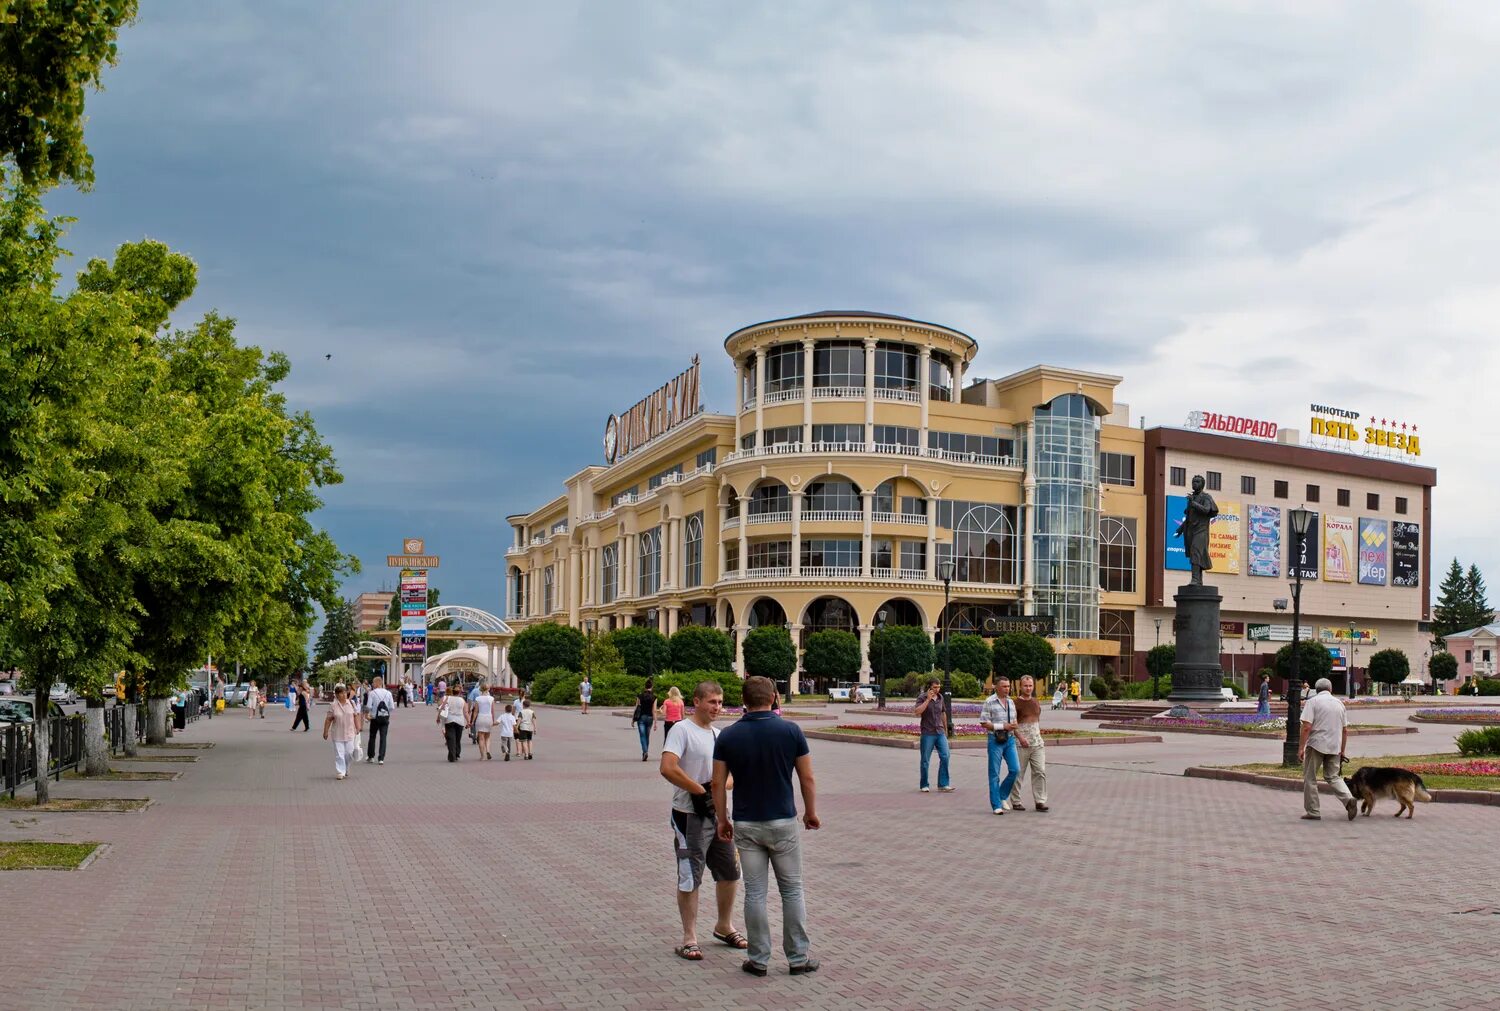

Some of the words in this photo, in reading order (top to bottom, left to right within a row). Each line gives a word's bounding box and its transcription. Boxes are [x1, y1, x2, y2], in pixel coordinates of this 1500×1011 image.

[1310, 403, 1360, 420] КИНОТЕАТР
[1311, 416, 1359, 441] ПЯТЬ
[1364, 427, 1420, 456] ЗВЕЗД
[1326, 522, 1353, 531] КОРАЛЛ
[1360, 549, 1385, 562] next
[1289, 568, 1295, 577] 4
[1300, 570, 1317, 578] ТАЖ
[1361, 563, 1386, 581] step
[1254, 625, 1270, 633] БАНК
